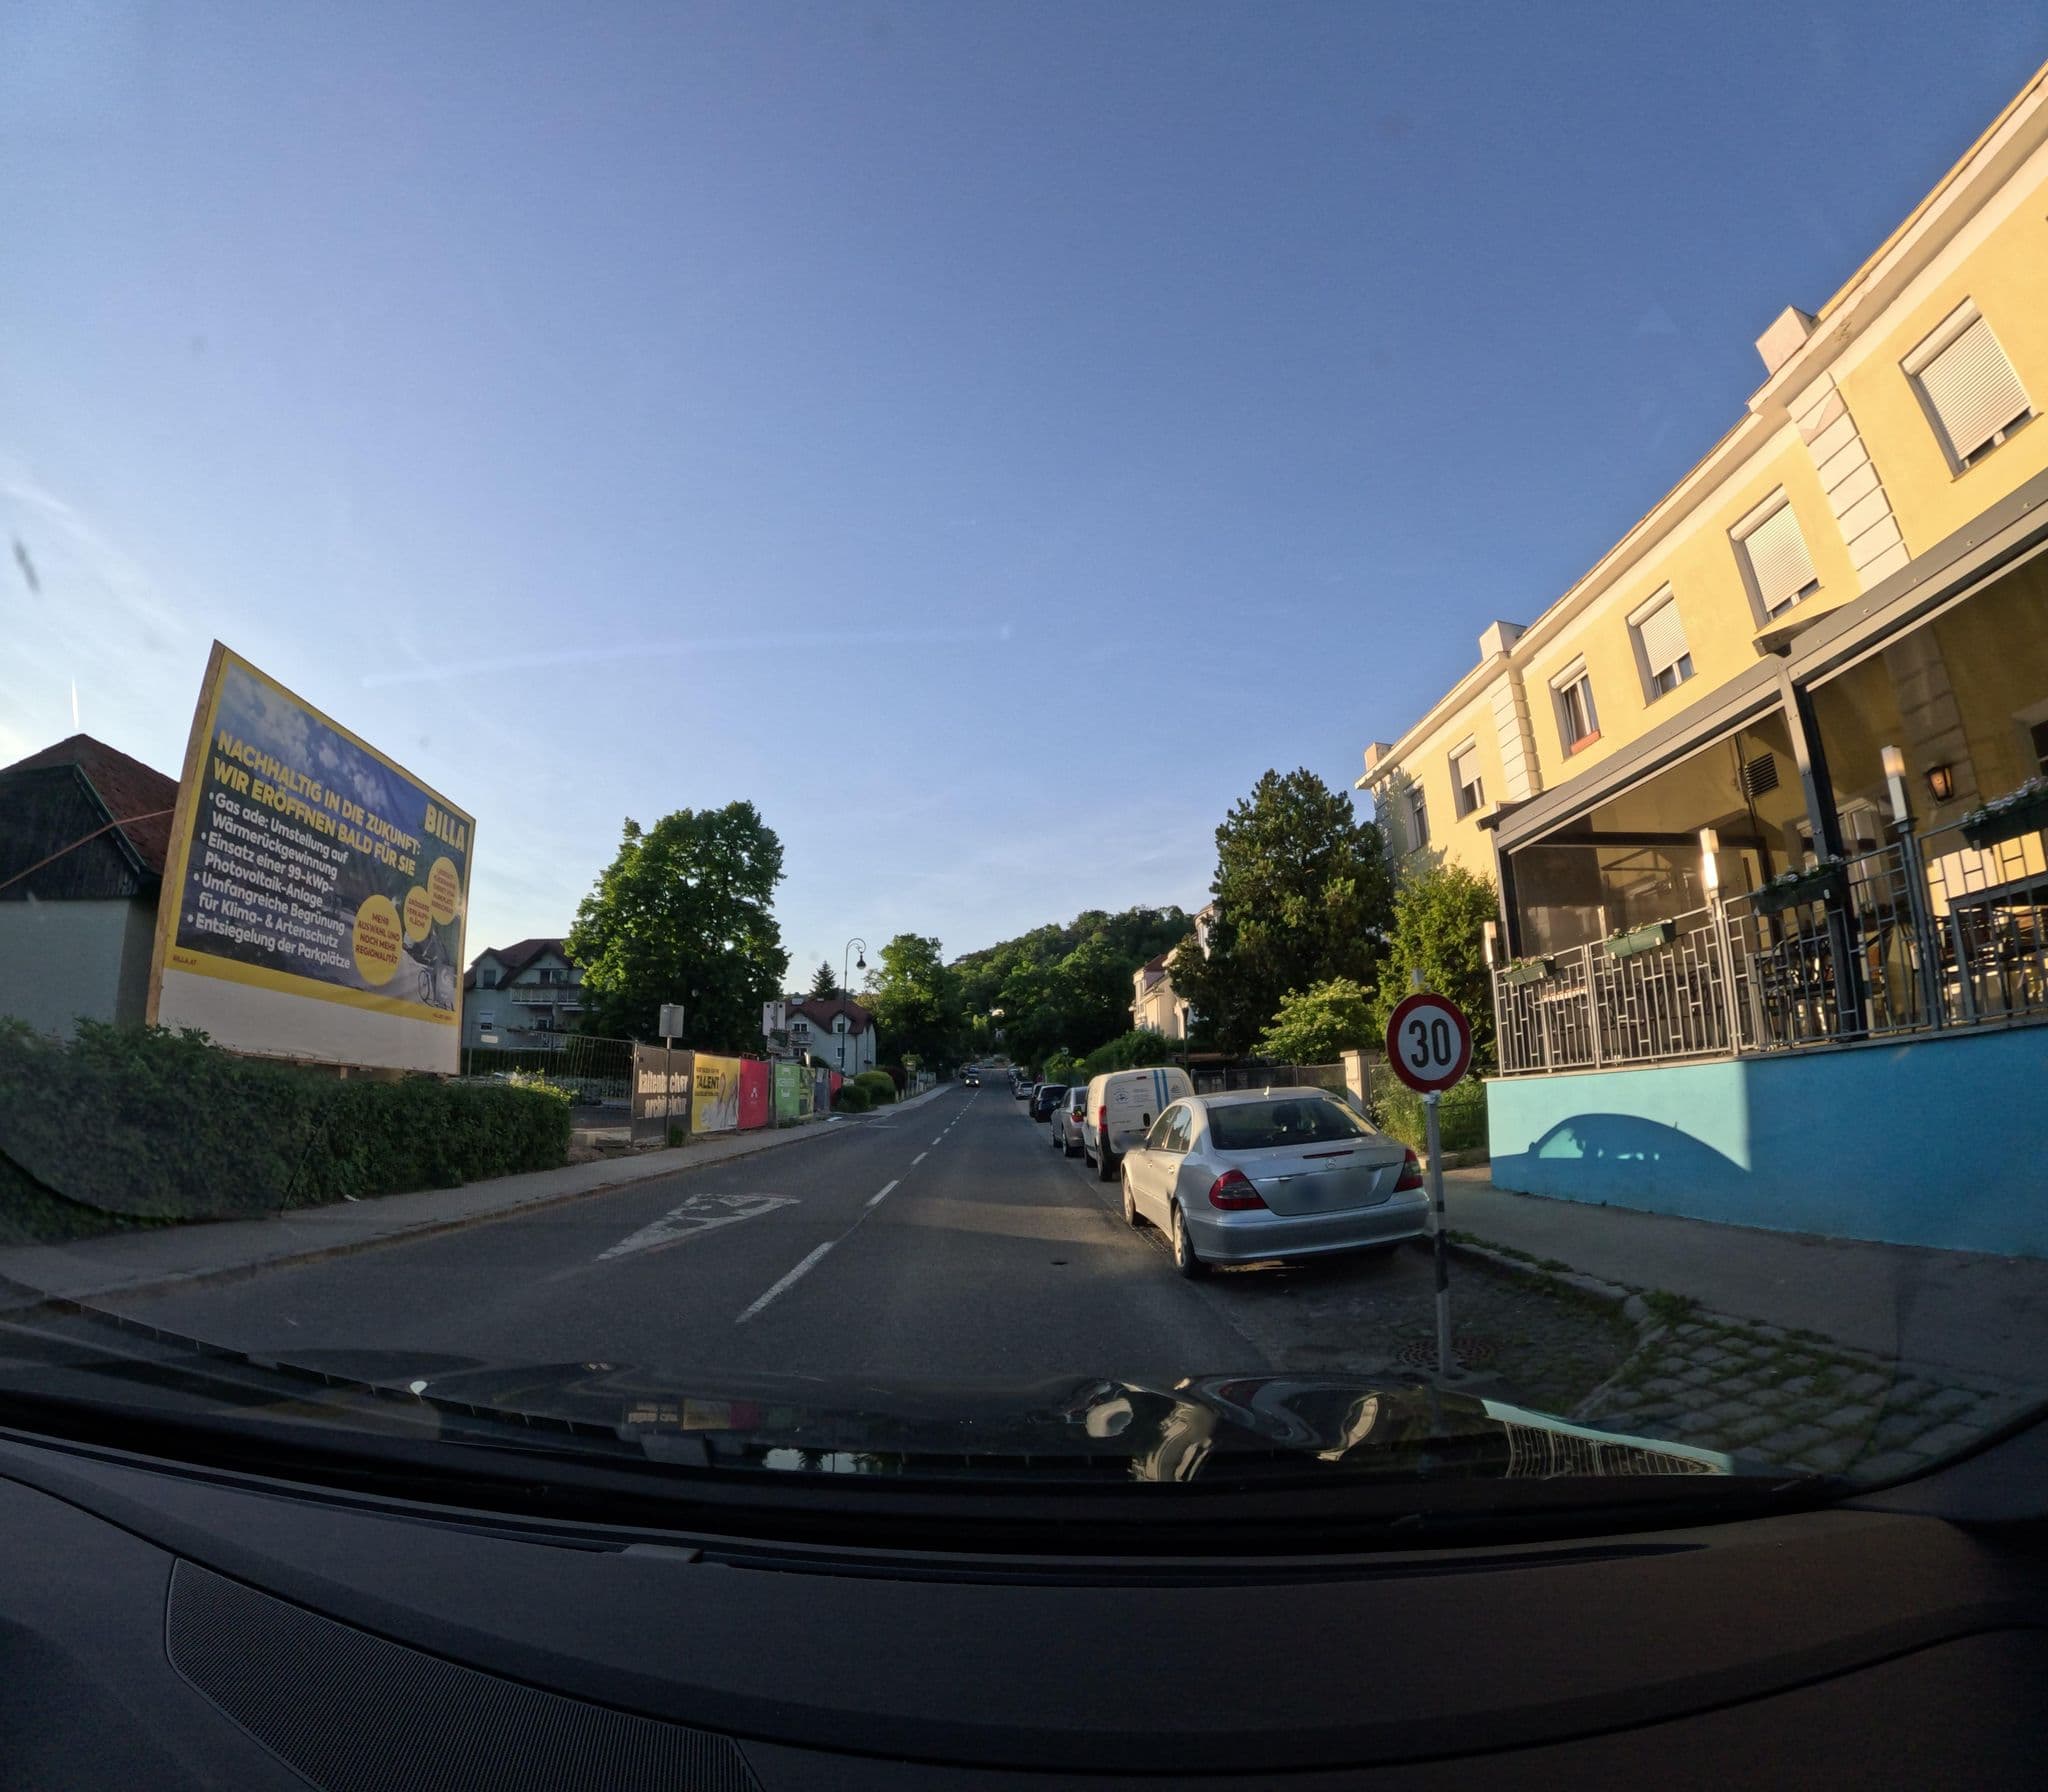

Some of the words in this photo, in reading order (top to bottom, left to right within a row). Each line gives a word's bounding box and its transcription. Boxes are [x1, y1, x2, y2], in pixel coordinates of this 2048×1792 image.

[214, 756, 249, 795] WIR
[251, 778, 337, 838] ERÖFFNEN
[337, 823, 373, 855] BALD
[373, 840, 397, 868] FÜR
[398, 854, 417, 877] SIE
[217, 729, 322, 802] NACHHALTIG
[324, 789, 340, 812] IN
[341, 799, 365, 827] DIE
[365, 812, 421, 856] ZUKUNFT:
[212, 811, 338, 881] Wärmerückgewinnung
[215, 792, 241, 816] Gas
[242, 807, 269, 829] ade:
[270, 817, 331, 860] Umstellung
[331, 848, 349, 865] auf
[424, 803, 465, 853] BILLA
[205, 851, 324, 908] Photovoltaik-Anlage
[208, 831, 255, 863] Einsatz
[256, 854, 287, 875] einer
[288, 865, 335, 895] 99-kWp-
[199, 892, 219, 912] für
[221, 899, 263, 924] Klima-
[264, 914, 274, 928] &
[275, 922, 339, 948] Artenschutz
[202, 871, 289, 914] Umfangreiche
[290, 903, 345, 936] Begrünung
[372, 913, 390, 927] MEHR
[195, 913, 276, 952] Entsiegelung
[277, 938, 297, 954] der
[298, 943, 351, 969] Parkplätze
[355, 944, 398, 964] REGIONALITÄT
[360, 933, 379, 946] NOCH
[379, 940, 397, 952] MEHR
[1408, 1018, 1451, 1068] 30
[638, 1069, 689, 1094] kallenbcher
[696, 1074, 720, 1089] TALENT
